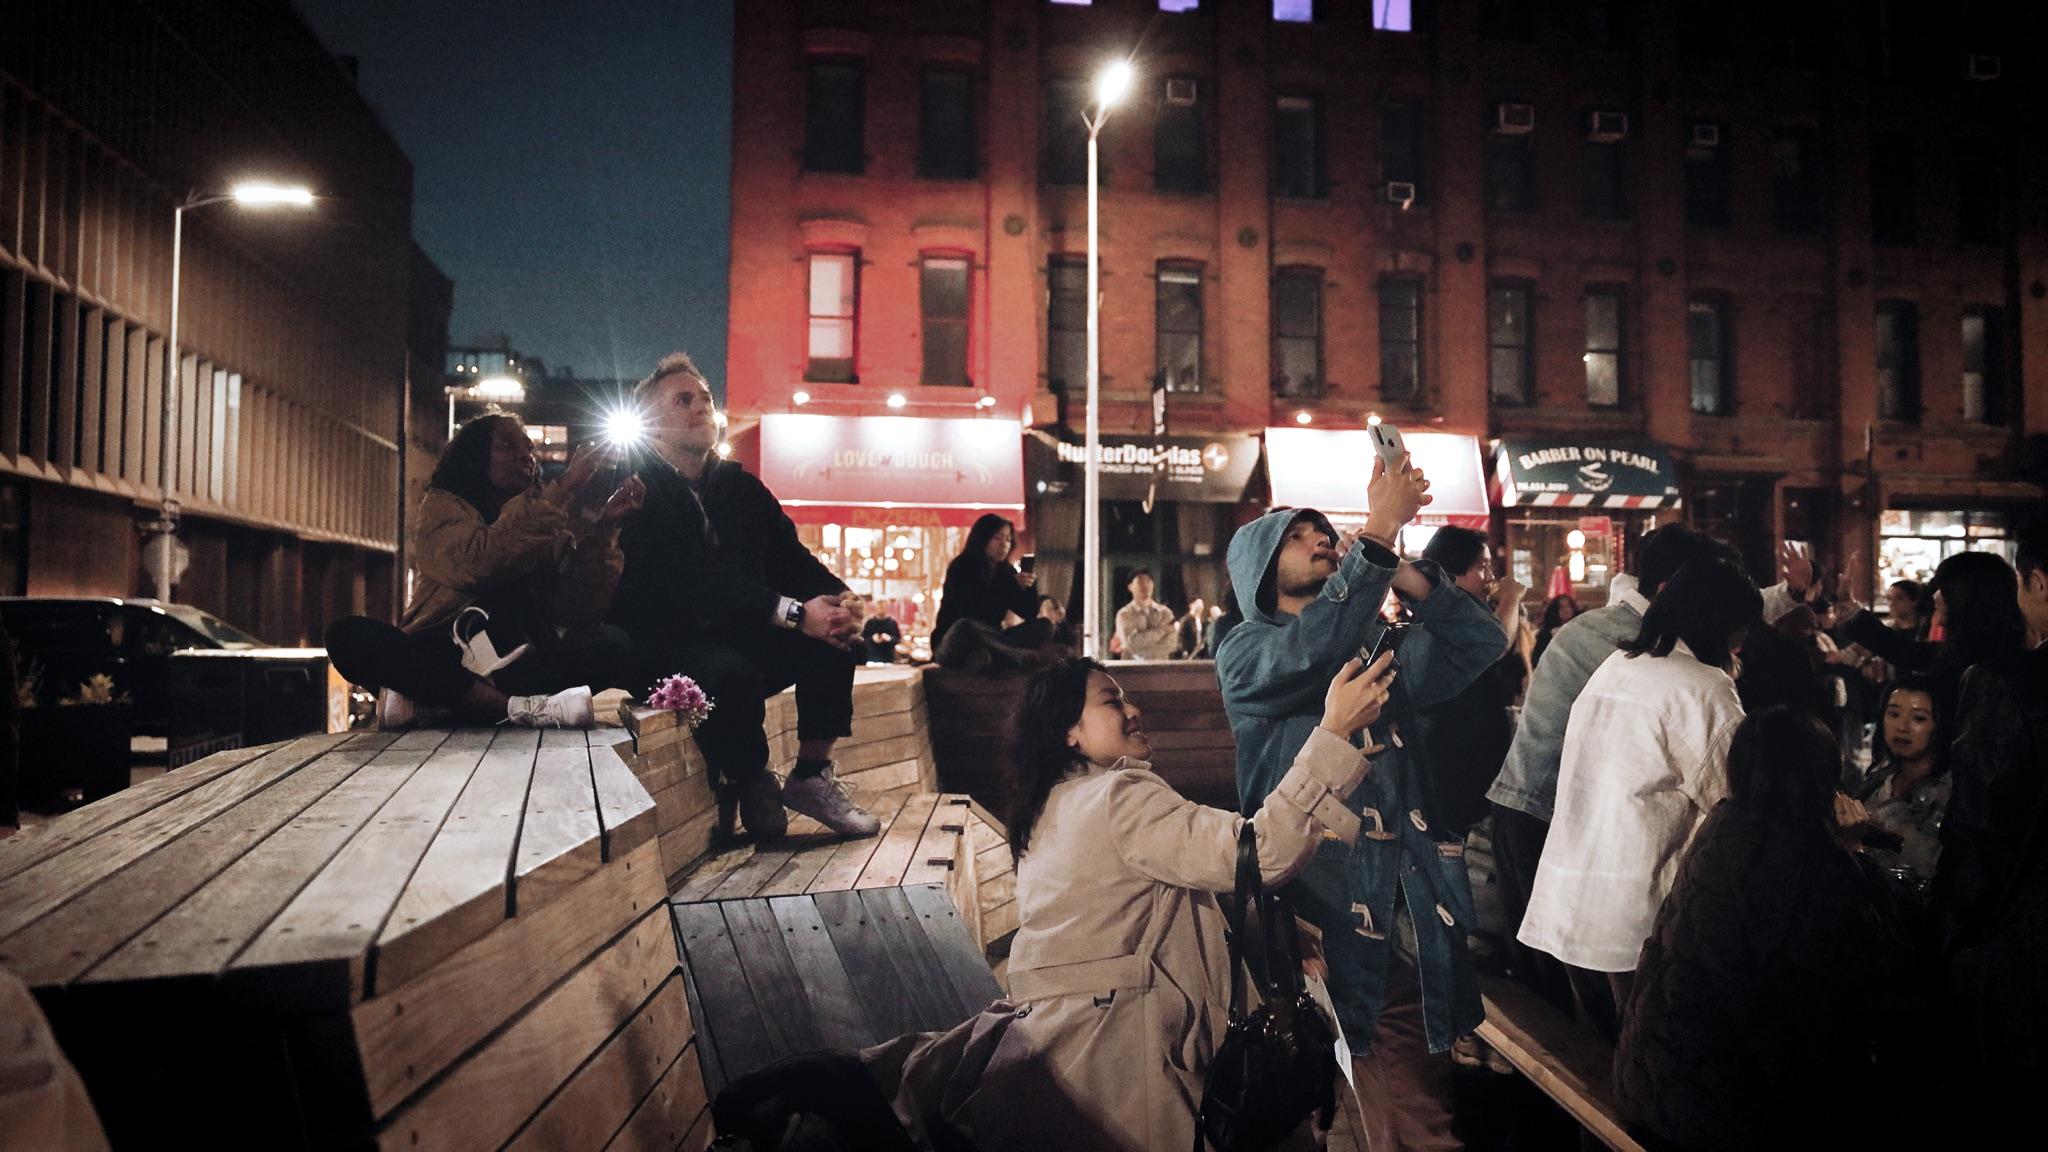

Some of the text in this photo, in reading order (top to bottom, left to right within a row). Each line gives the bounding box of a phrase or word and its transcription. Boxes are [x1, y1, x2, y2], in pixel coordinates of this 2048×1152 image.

[833, 449, 877, 467] LOVE
[894, 450, 953, 469] DOUGH
[1058, 442, 1201, 465] HuterDoulas
[1519, 447, 1660, 474] BARBER ON PEARL
[852, 508, 942, 528] PIZZERIA
